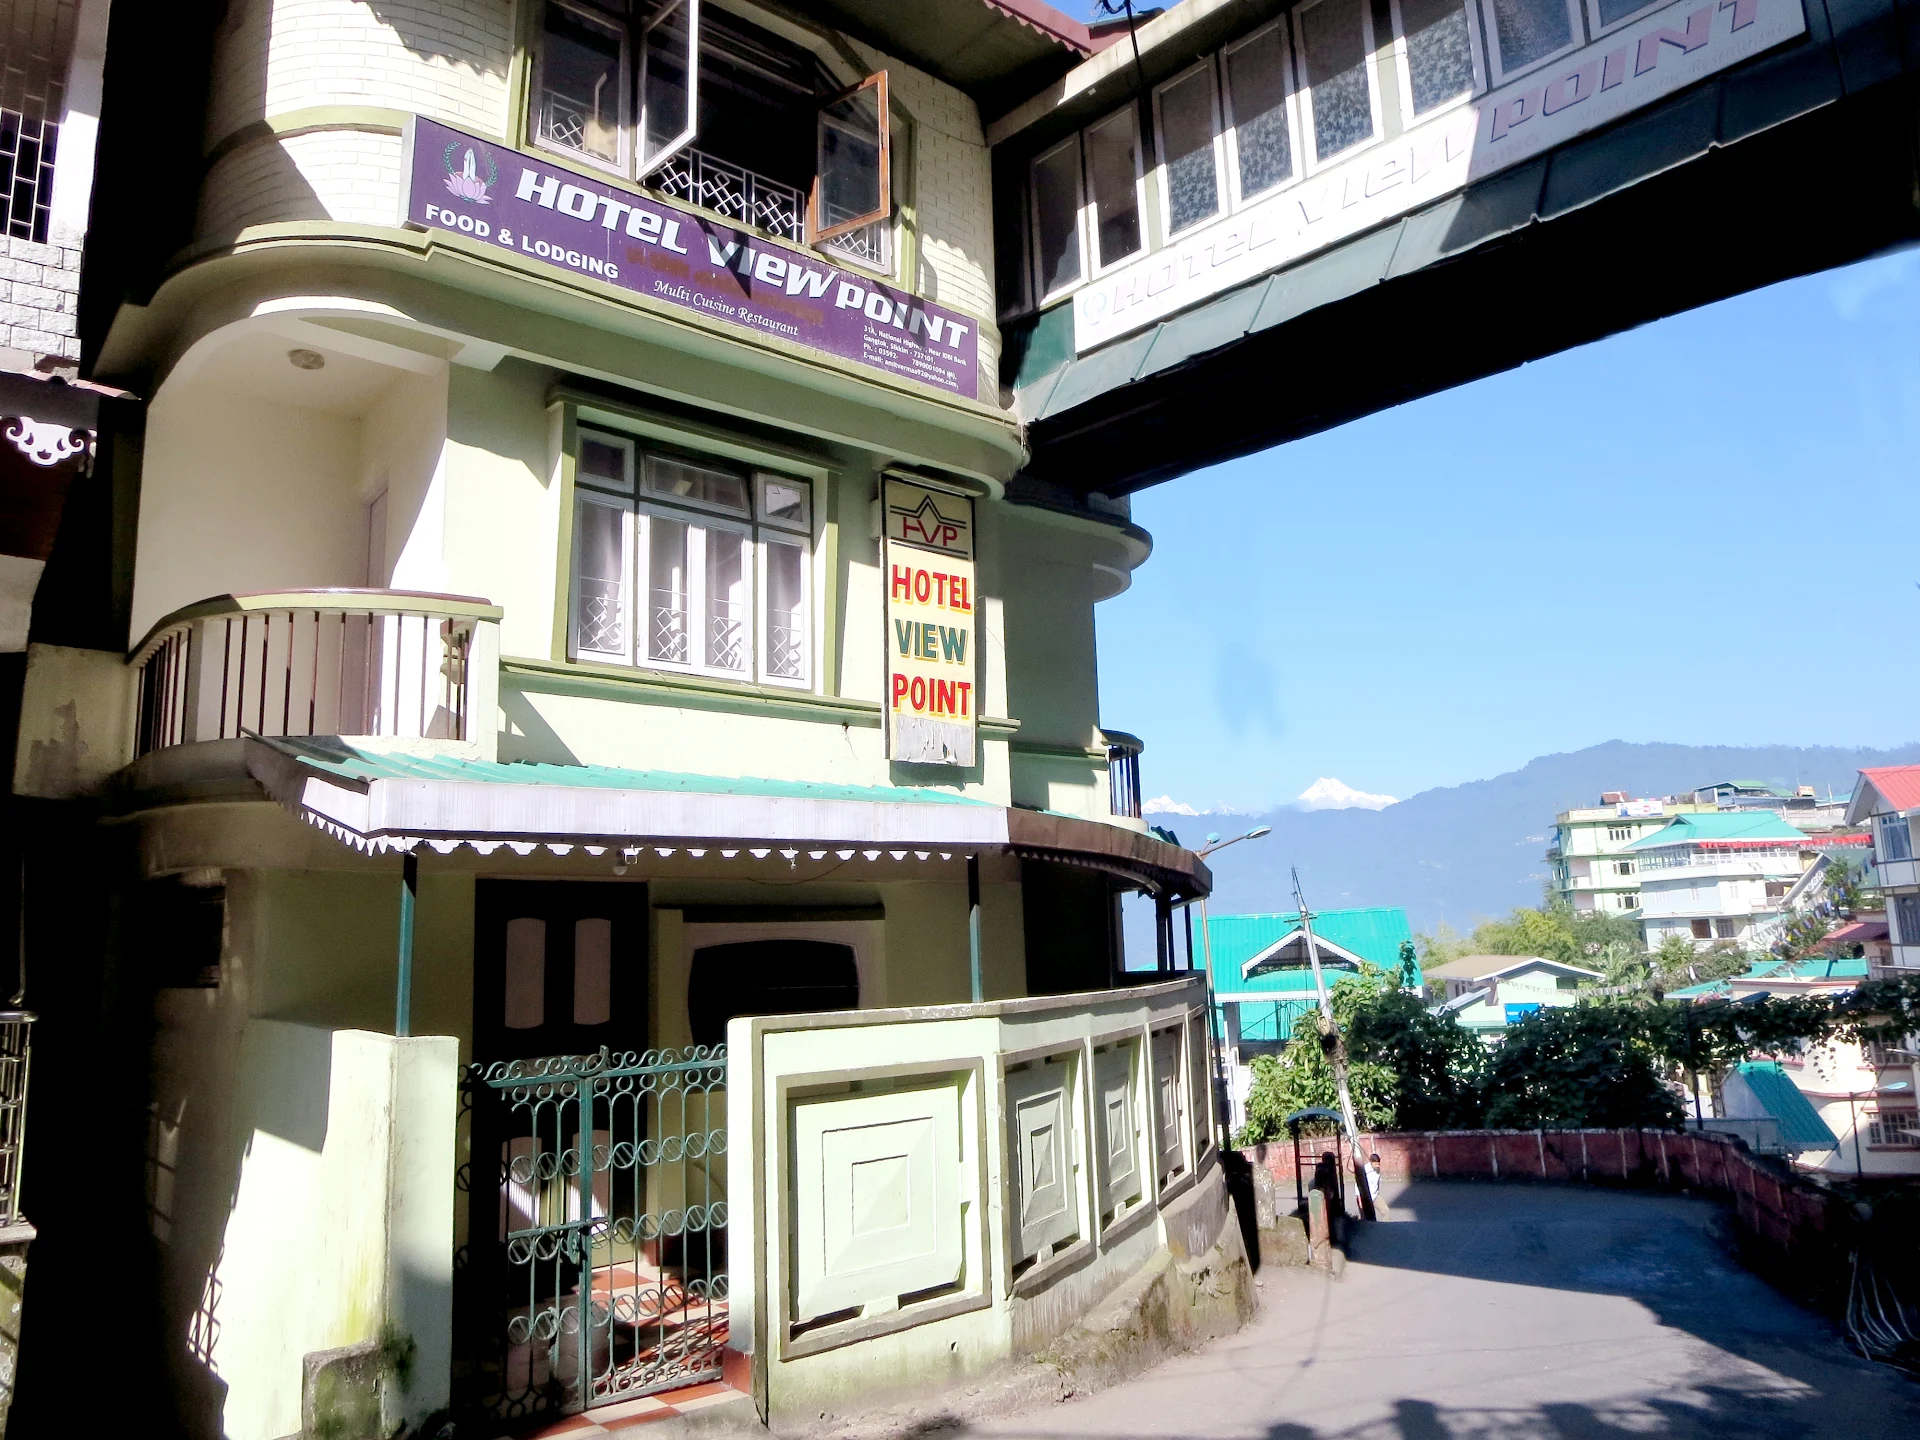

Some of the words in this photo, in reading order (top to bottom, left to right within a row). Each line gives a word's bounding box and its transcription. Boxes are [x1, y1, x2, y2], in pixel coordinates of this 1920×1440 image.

[425, 203, 491, 238] FOOD
[498, 228, 515, 247] &
[521, 235, 619, 279] LODGING
[515, 168, 688, 255] HOTEL
[835, 280, 970, 349] POINT
[653, 280, 691, 301] Multi
[692, 293, 735, 316] Cuisine
[738, 307, 799, 336] Restaurant
[878, 330, 902, 344] National
[928, 347, 942, 357] Near
[953, 355, 967, 366] Bank
[890, 342, 909, 355] Sikkim
[902, 516, 958, 547] HVP
[891, 563, 972, 614] HOTEL
[894, 618, 969, 664] VIEW
[891, 672, 971, 719] POINT
